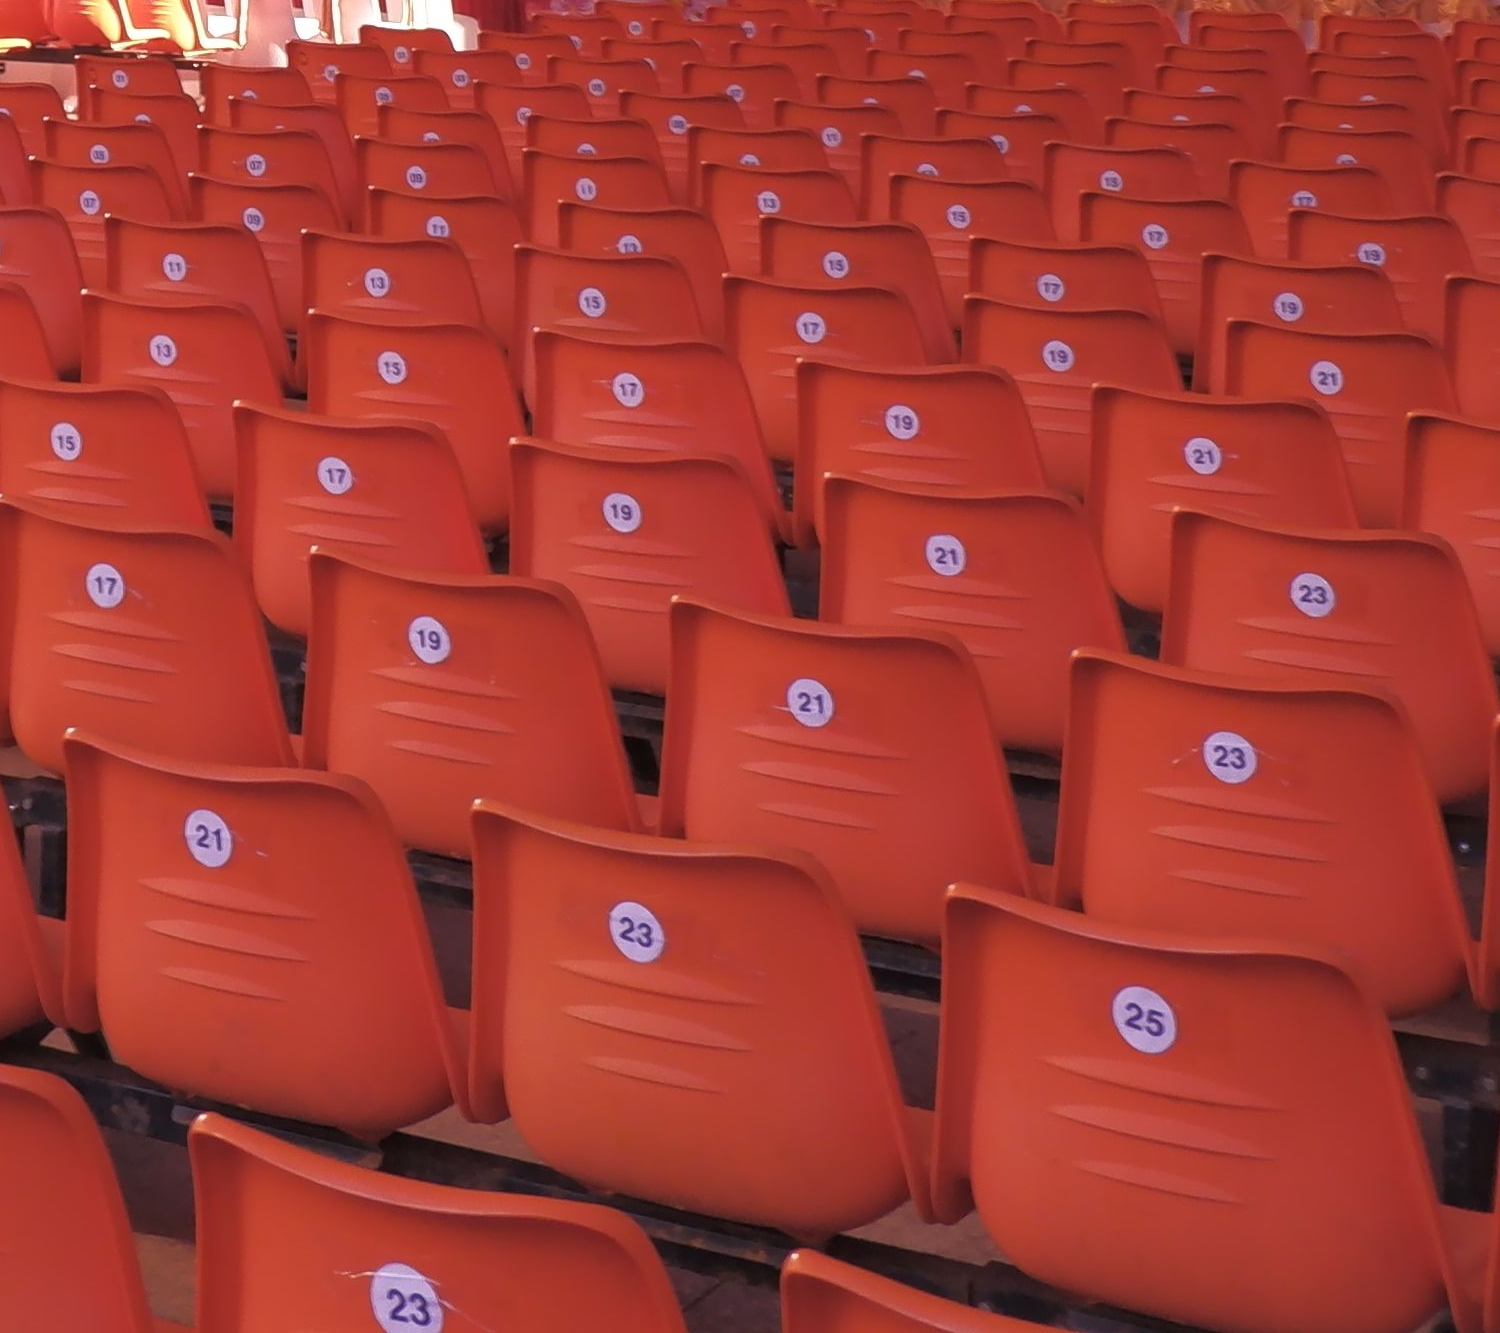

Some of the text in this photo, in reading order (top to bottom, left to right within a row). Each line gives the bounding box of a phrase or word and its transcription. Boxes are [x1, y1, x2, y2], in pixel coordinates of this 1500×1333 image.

[370, 277, 386, 289] 13
[584, 296, 600, 309] 15
[1281, 301, 1299, 314] 19
[802, 322, 820, 335] 17
[156, 344, 172, 357] 13
[1050, 350, 1068, 363] 19
[384, 361, 401, 376] 15
[1318, 371, 1337, 386] 21
[620, 383, 637, 397] 17
[892, 415, 913, 430] 19
[57, 435, 75, 451] 15
[1193, 449, 1214, 464] 21
[326, 468, 346, 484] 17
[611, 504, 632, 521] 19
[935, 547, 958, 565] 21
[95, 577, 117, 595] 17
[1300, 585, 1328, 604] 23
[417, 630, 440, 650] 19
[798, 693, 823, 714] 21
[1214, 745, 1246, 769] 23
[196, 825, 222, 851] 21
[620, 917, 653, 947] 23
[1125, 1003, 1164, 1036] 25
[387, 1289, 432, 1326] 23
